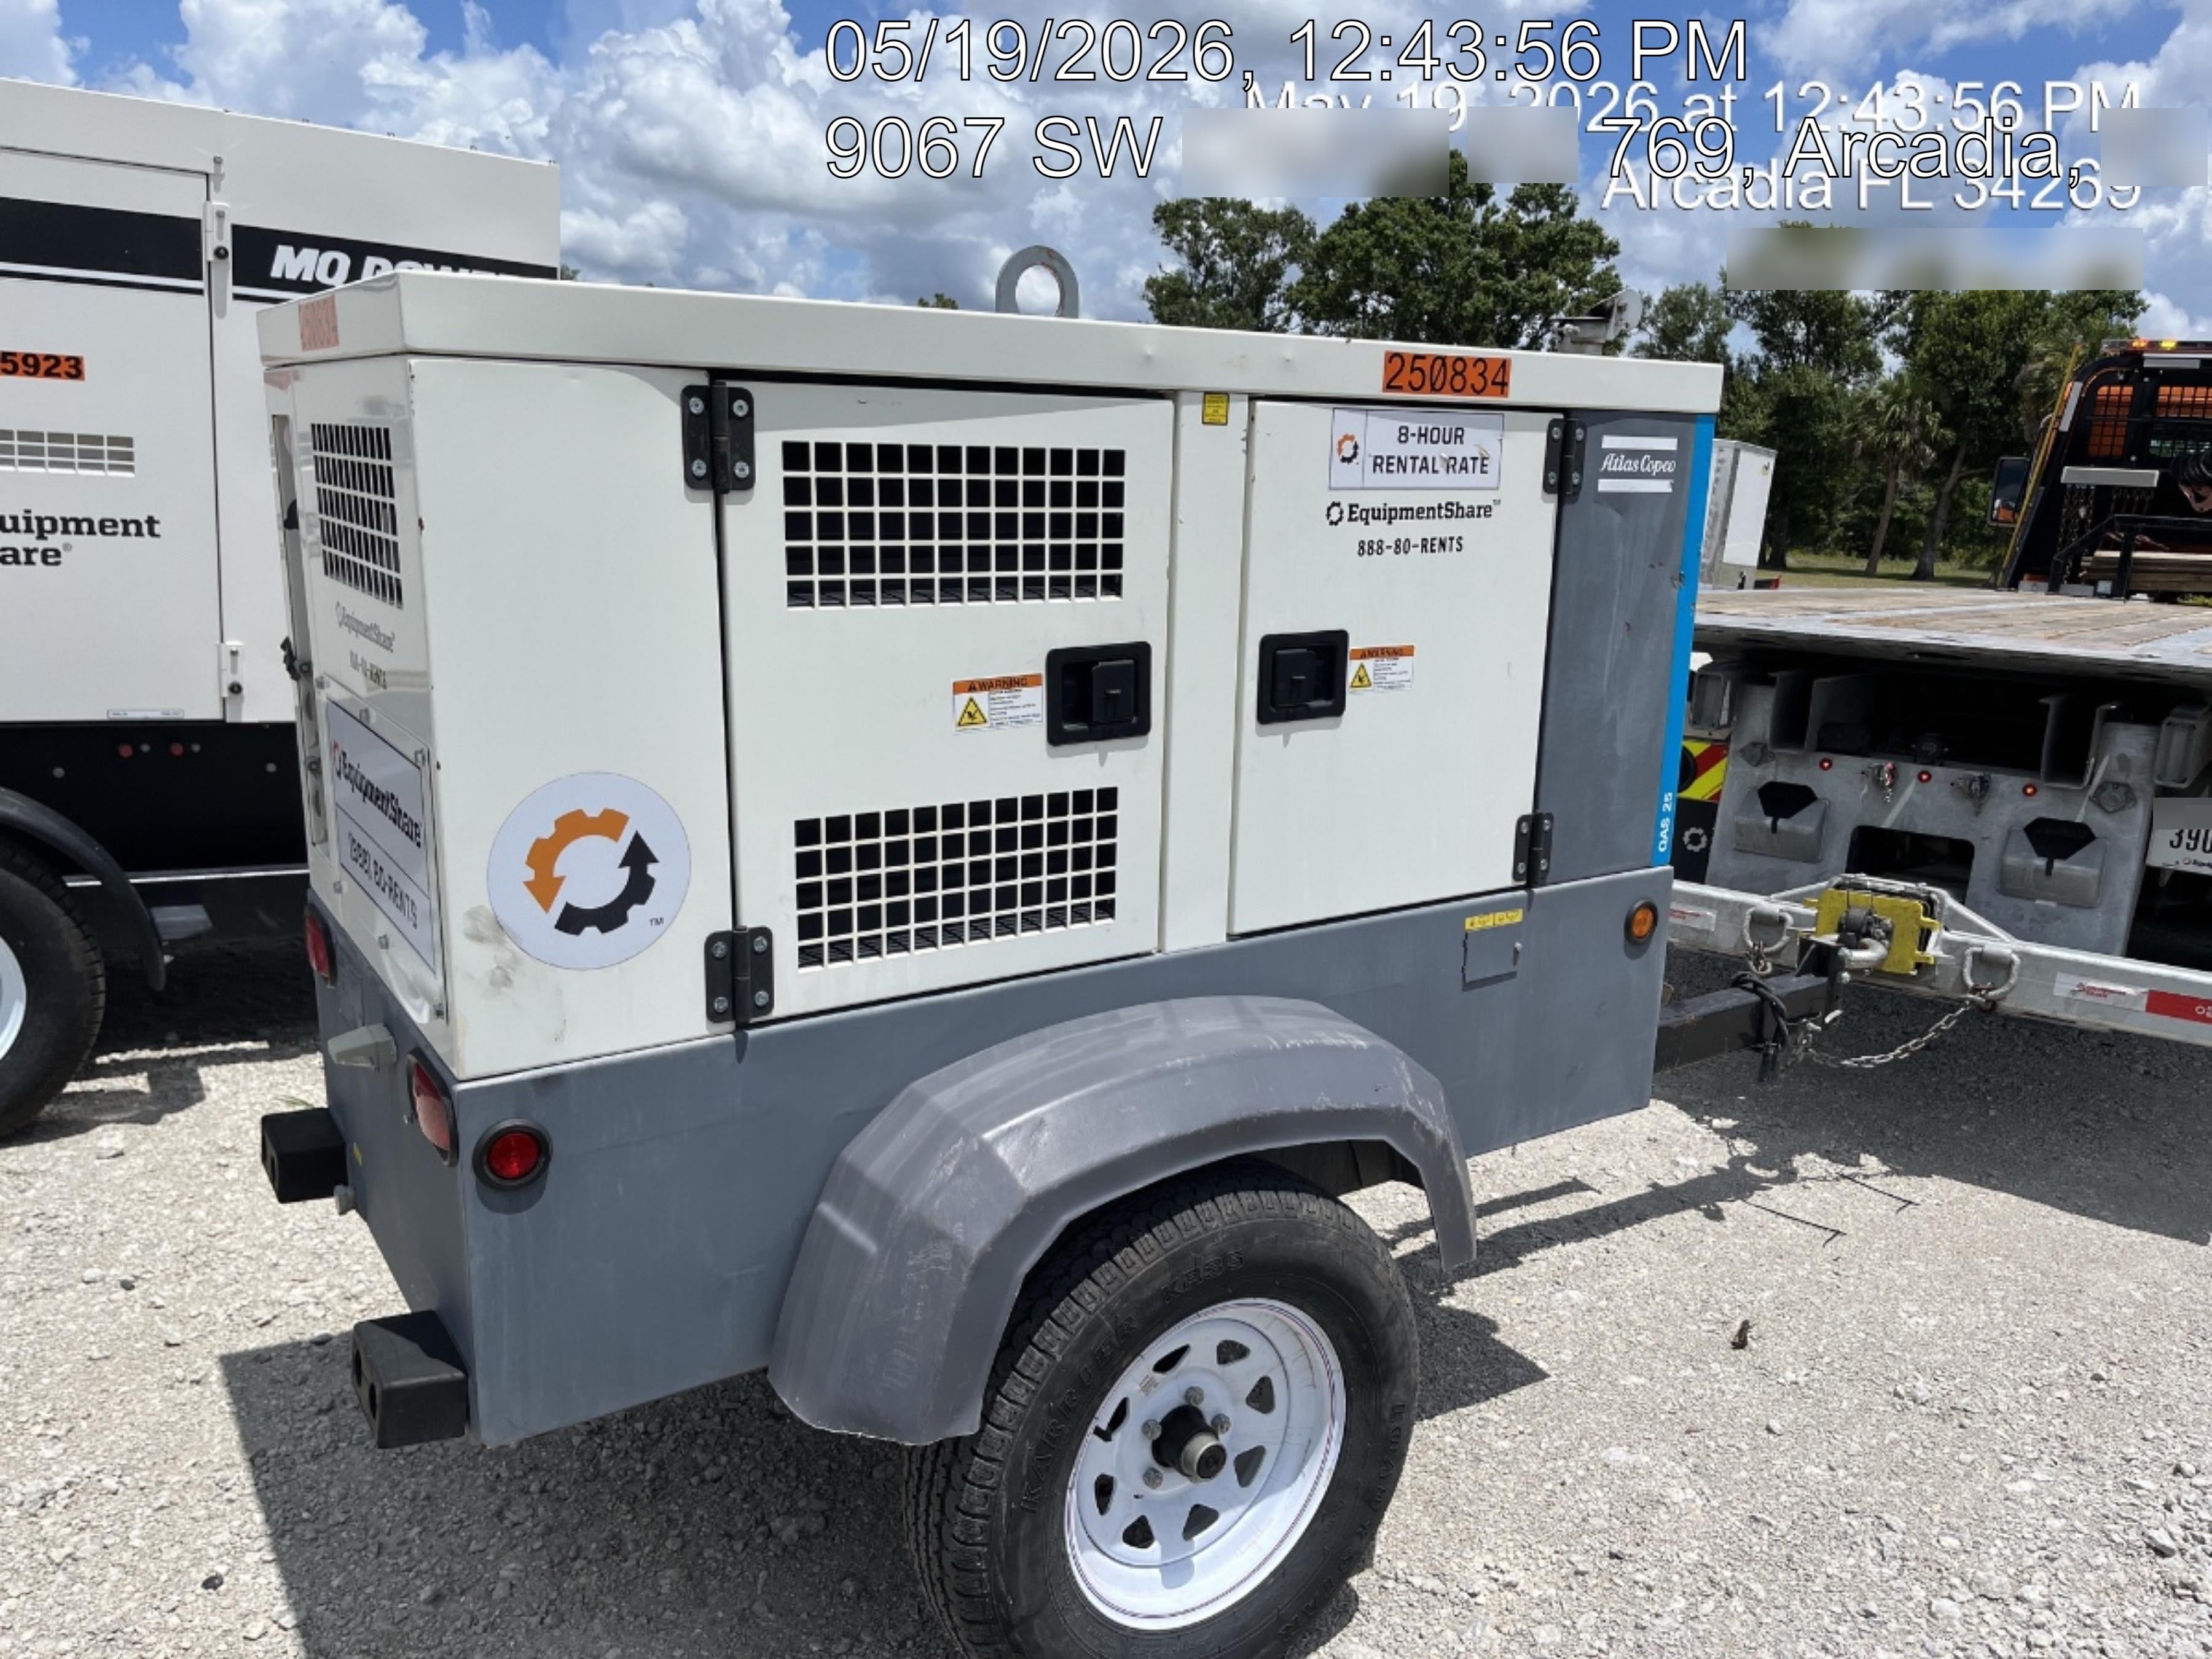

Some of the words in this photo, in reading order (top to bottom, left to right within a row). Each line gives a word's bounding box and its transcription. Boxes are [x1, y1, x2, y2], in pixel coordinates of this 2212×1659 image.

[270, 245, 351, 287] MQ
[1386, 353, 1508, 395] 250834
[1398, 426, 1464, 445] 8-HOUR
[1373, 455, 1439, 474] RENTAL
[1446, 457, 1489, 474] RATE
[1599, 453, 1639, 472] Atlas
[1640, 455, 1676, 476] Copco
[1357, 536, 1464, 557] 888-80-RENTS
[978, 677, 1028, 691] WARNING
[1662, 792, 1673, 812] 25
[1658, 817, 1671, 852] QAS
